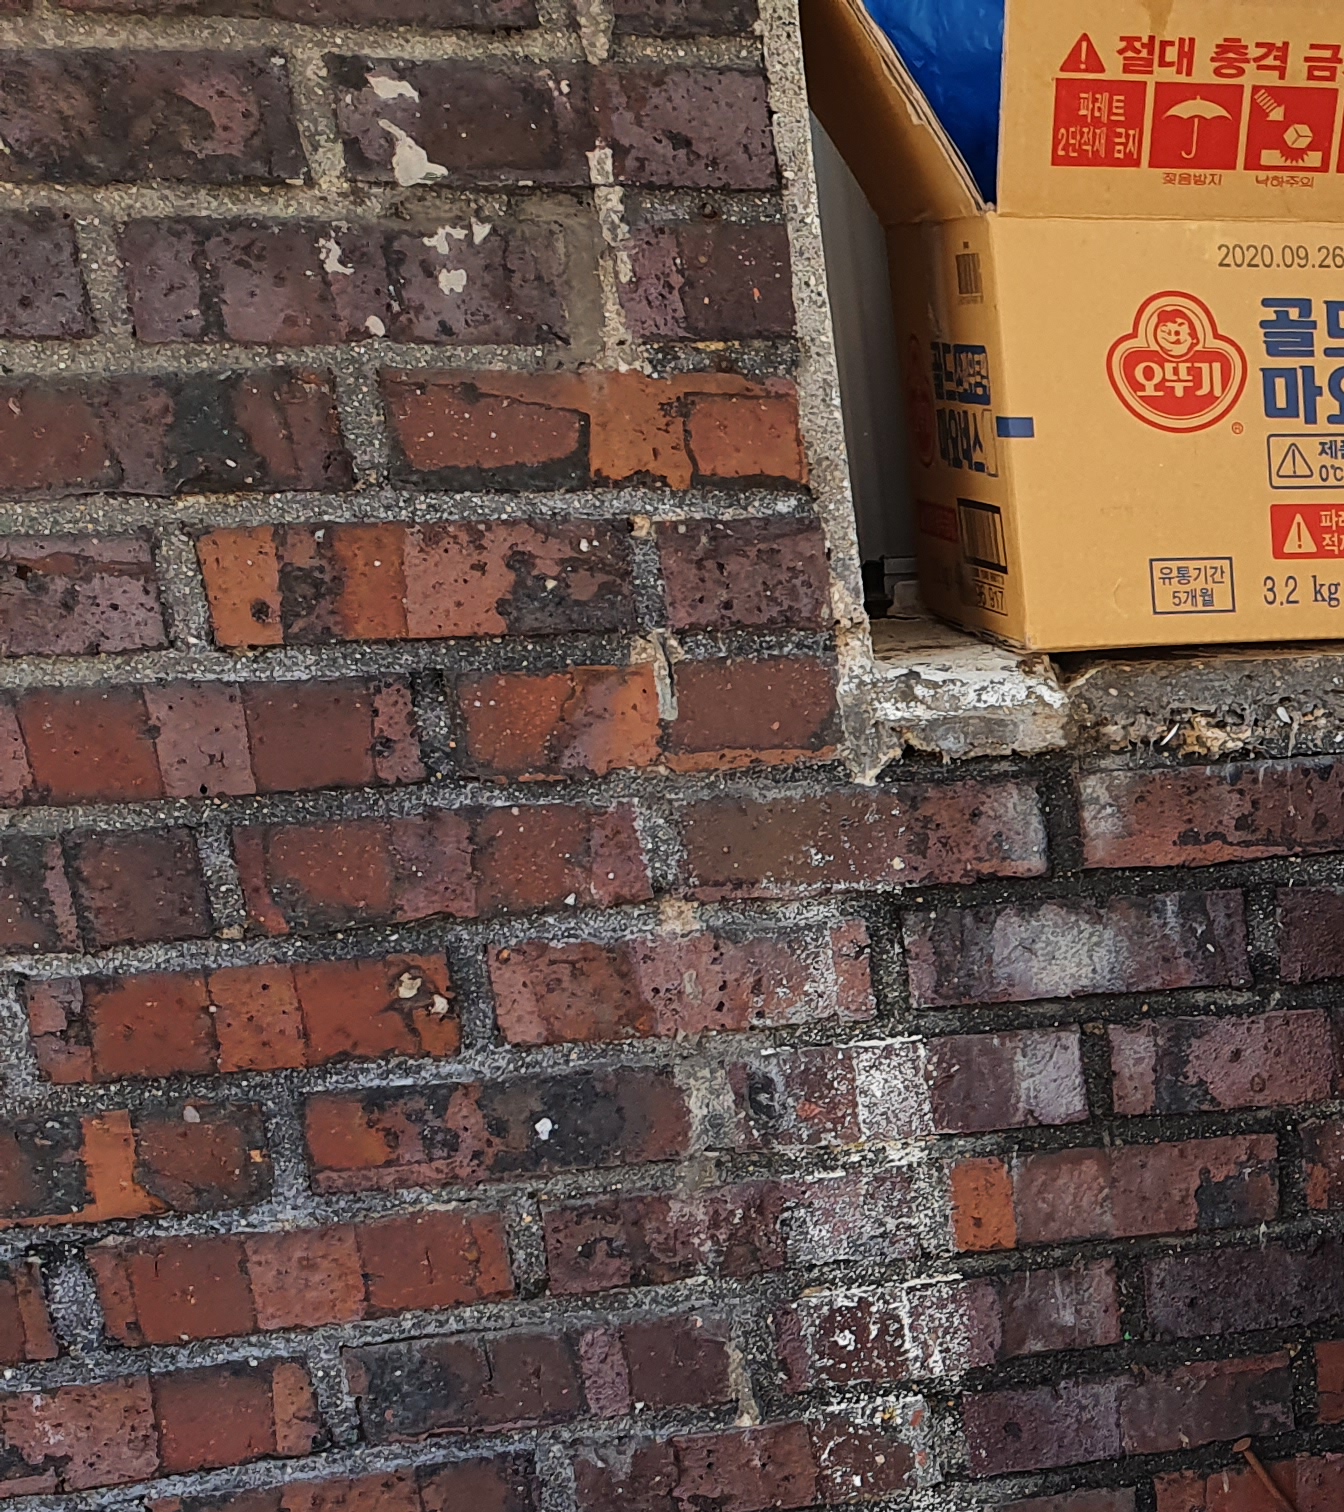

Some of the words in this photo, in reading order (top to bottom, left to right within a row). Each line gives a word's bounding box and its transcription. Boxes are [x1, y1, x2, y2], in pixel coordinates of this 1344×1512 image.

[1116, 34, 1196, 77] 절대
[1209, 37, 1290, 81] 충격
[1078, 91, 1126, 123] 파레트
[1057, 126, 1107, 159] 2단적재
[1113, 127, 1140, 159] 금지
[1255, 175, 1315, 188] 낙하주의
[1134, 361, 1223, 398] 오뚜기
[1158, 565, 1225, 586] 유통기간
[1263, 575, 1300, 607] 3.2
[1311, 574, 1341, 608] kg
[1172, 587, 1215, 608] 5개월
